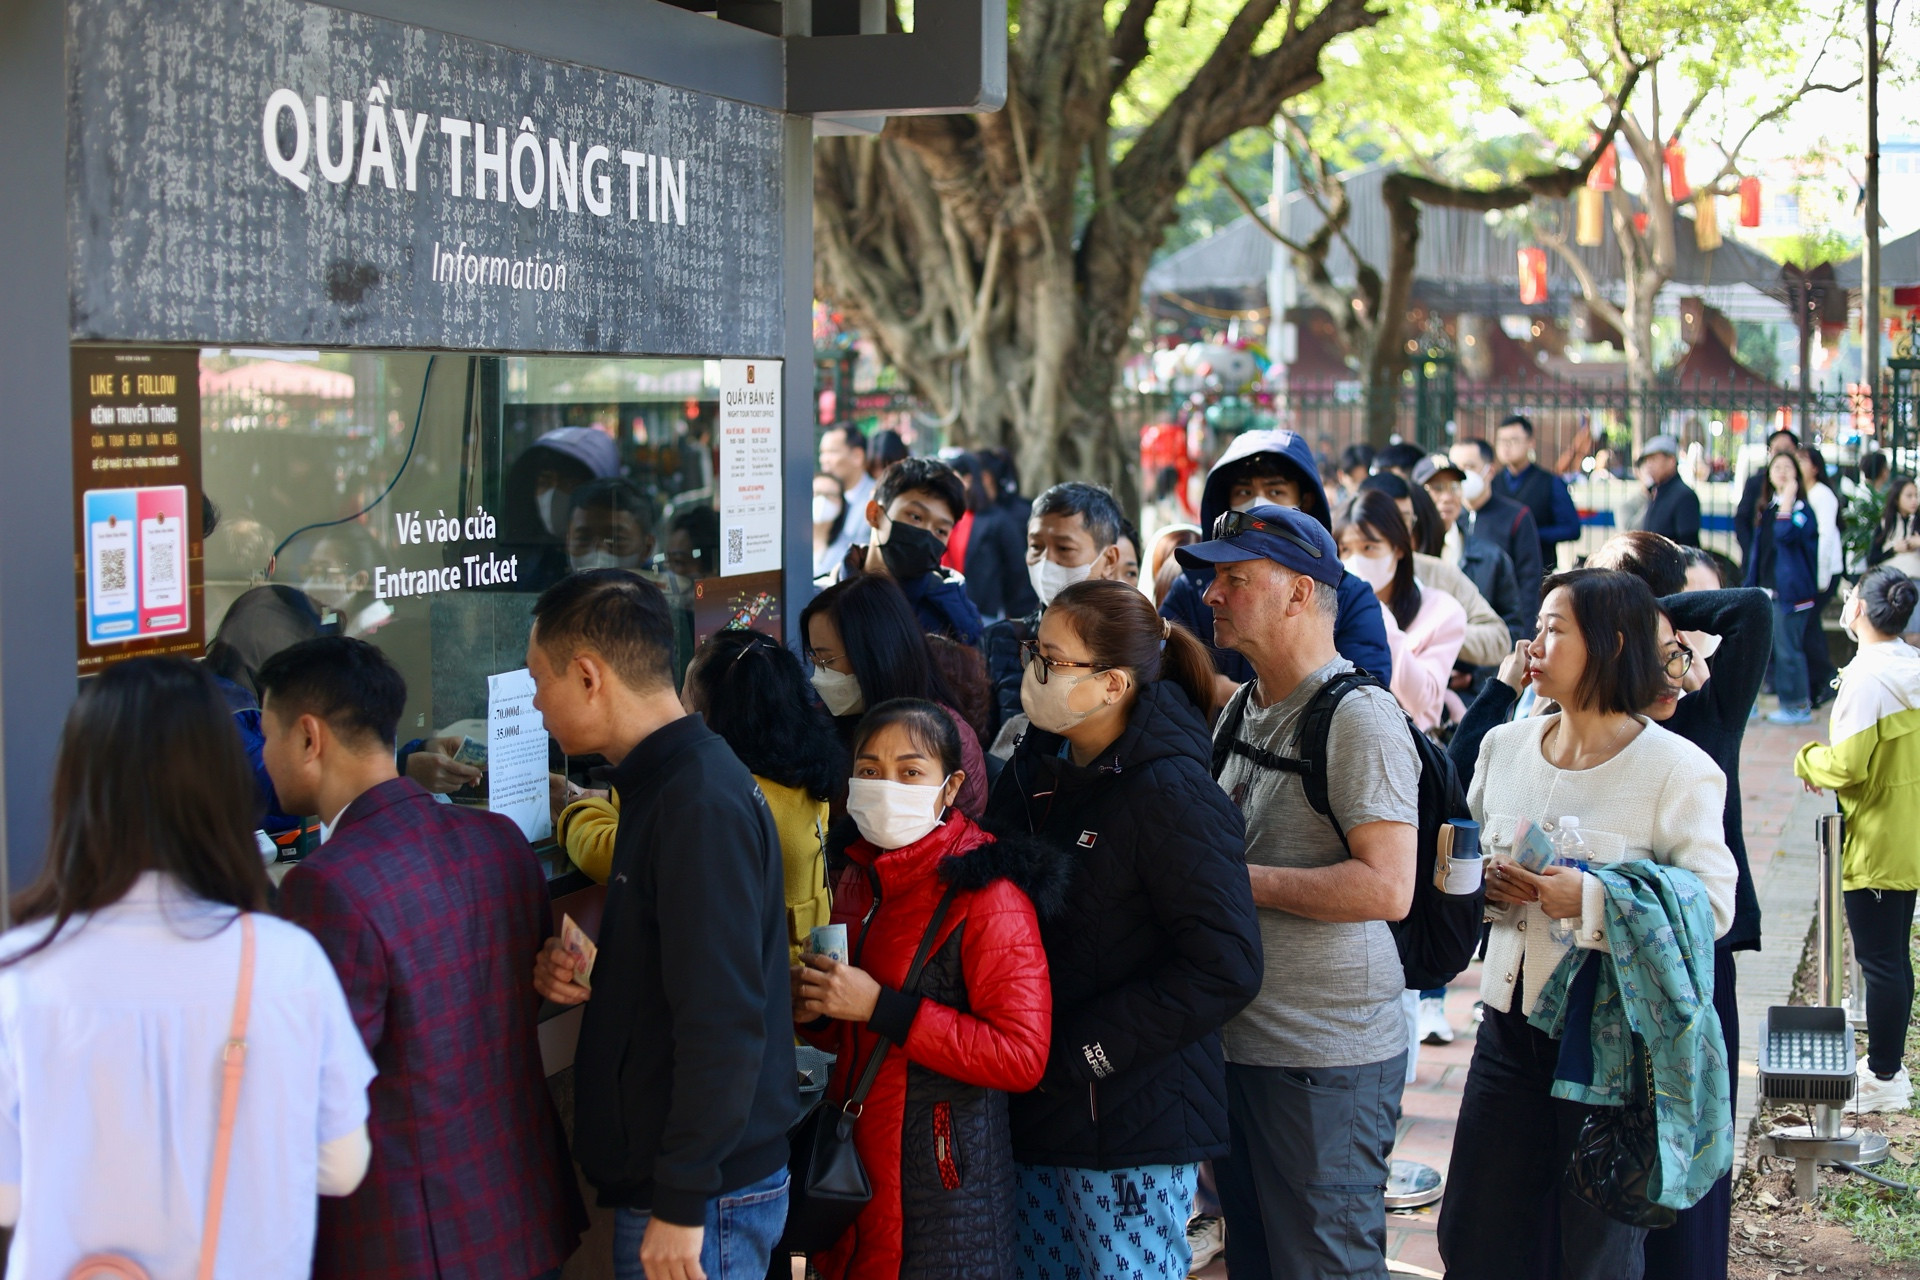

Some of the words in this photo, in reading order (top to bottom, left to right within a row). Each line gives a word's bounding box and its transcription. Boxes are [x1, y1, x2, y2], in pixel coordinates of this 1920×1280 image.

[263, 79, 428, 193] QUẦY
[440, 116, 612, 217] THÔNG
[621, 149, 686, 226] TIN
[432, 241, 567, 292] Information
[90, 374, 114, 395] LIKE
[122, 375, 131, 396] &
[138, 374, 177, 395] FOLLOW
[90, 404, 115, 425] KÊNH
[150, 404, 177, 424] THÔNG
[109, 434, 124, 447] TOUR
[396, 510, 422, 545] Vé
[425, 509, 461, 543] vào
[464, 505, 496, 541] cửa
[374, 566, 461, 599] Entrance
[463, 551, 518, 587] Ticket
[1114, 1172, 1148, 1216] LA
